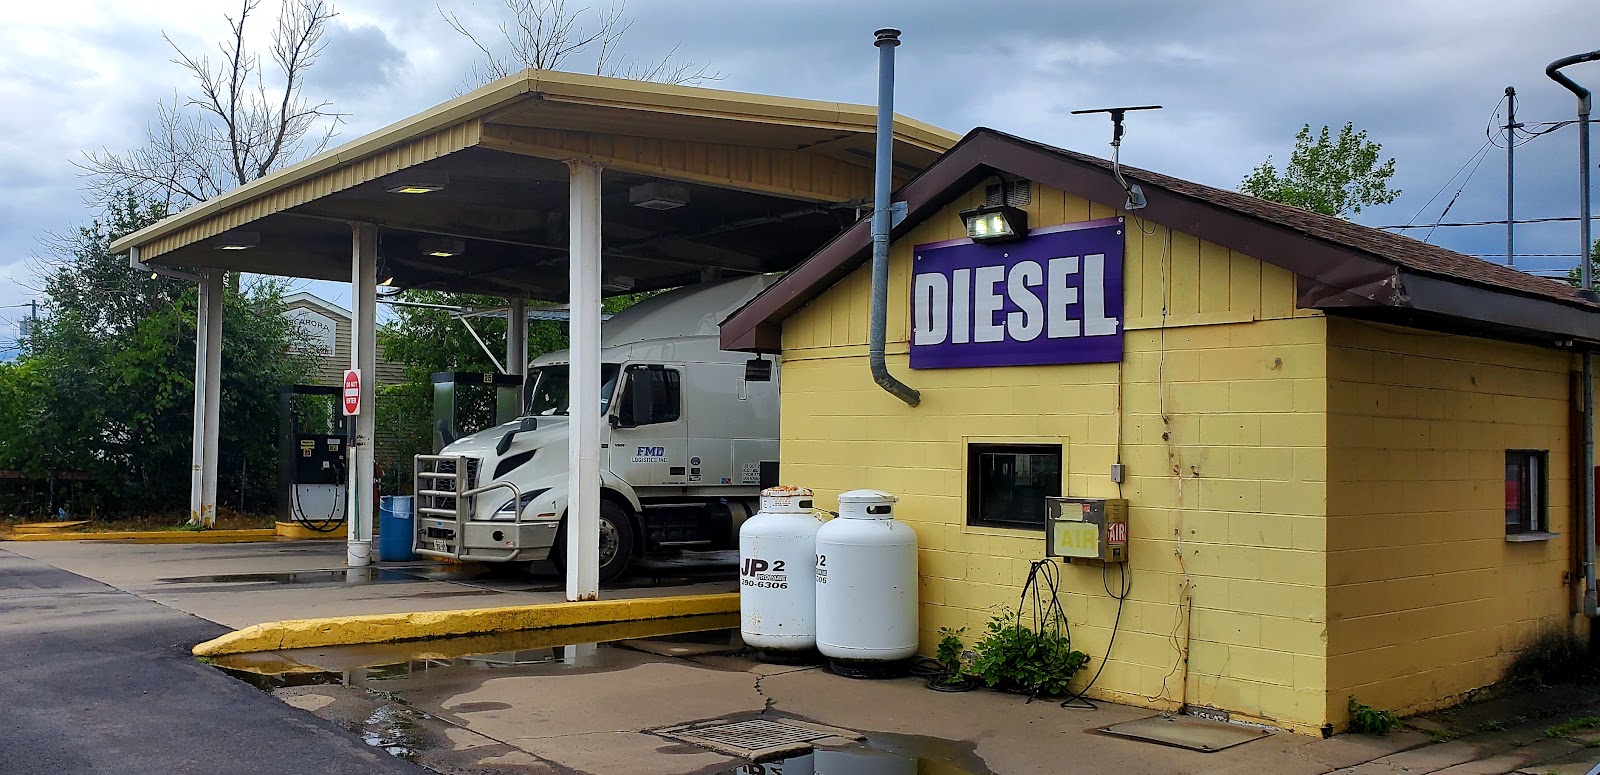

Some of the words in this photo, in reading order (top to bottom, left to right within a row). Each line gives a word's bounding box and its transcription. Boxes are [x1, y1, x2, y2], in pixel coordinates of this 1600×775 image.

[914, 253, 1117, 346] DIESEL
[289, 318, 331, 332] SCARORA
[637, 446, 665, 457] FMD
[551, 500, 557, 509] 1
[1061, 528, 1095, 549] AIR
[1109, 524, 1125, 542] AIR
[741, 558, 769, 577] JP
[772, 560, 786, 572] 2
